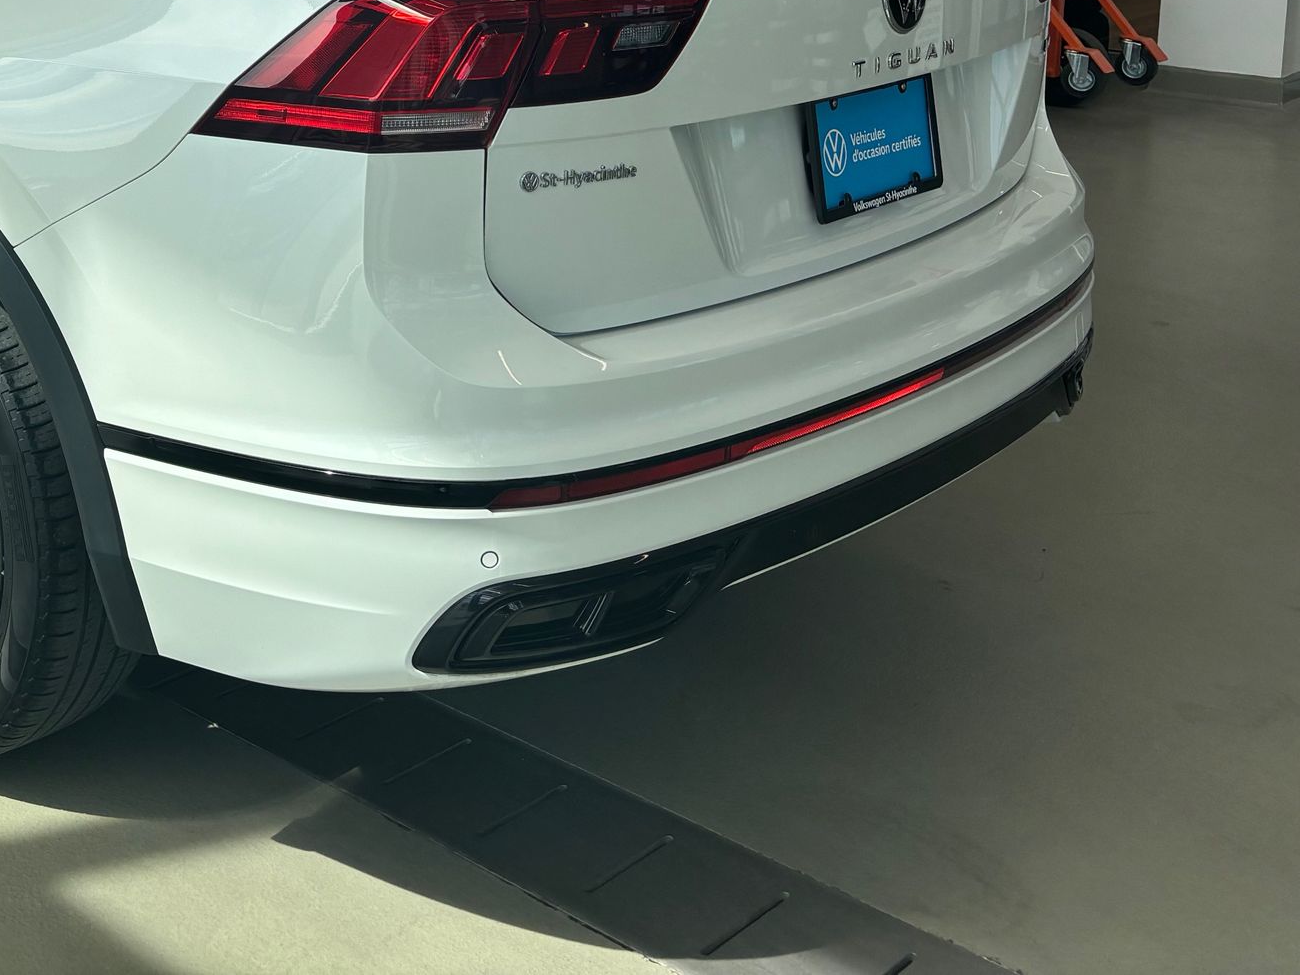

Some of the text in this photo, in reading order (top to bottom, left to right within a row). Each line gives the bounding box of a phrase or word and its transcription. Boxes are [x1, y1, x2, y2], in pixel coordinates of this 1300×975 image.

[852, 38, 955, 78] TIGUAN
[850, 128, 886, 146] Véhicules
[852, 134, 922, 163] d'occasion certifiés
[540, 163, 638, 188] St-Hyacinthe
[852, 185, 918, 212] Volkswagen St-Hyacinthe
